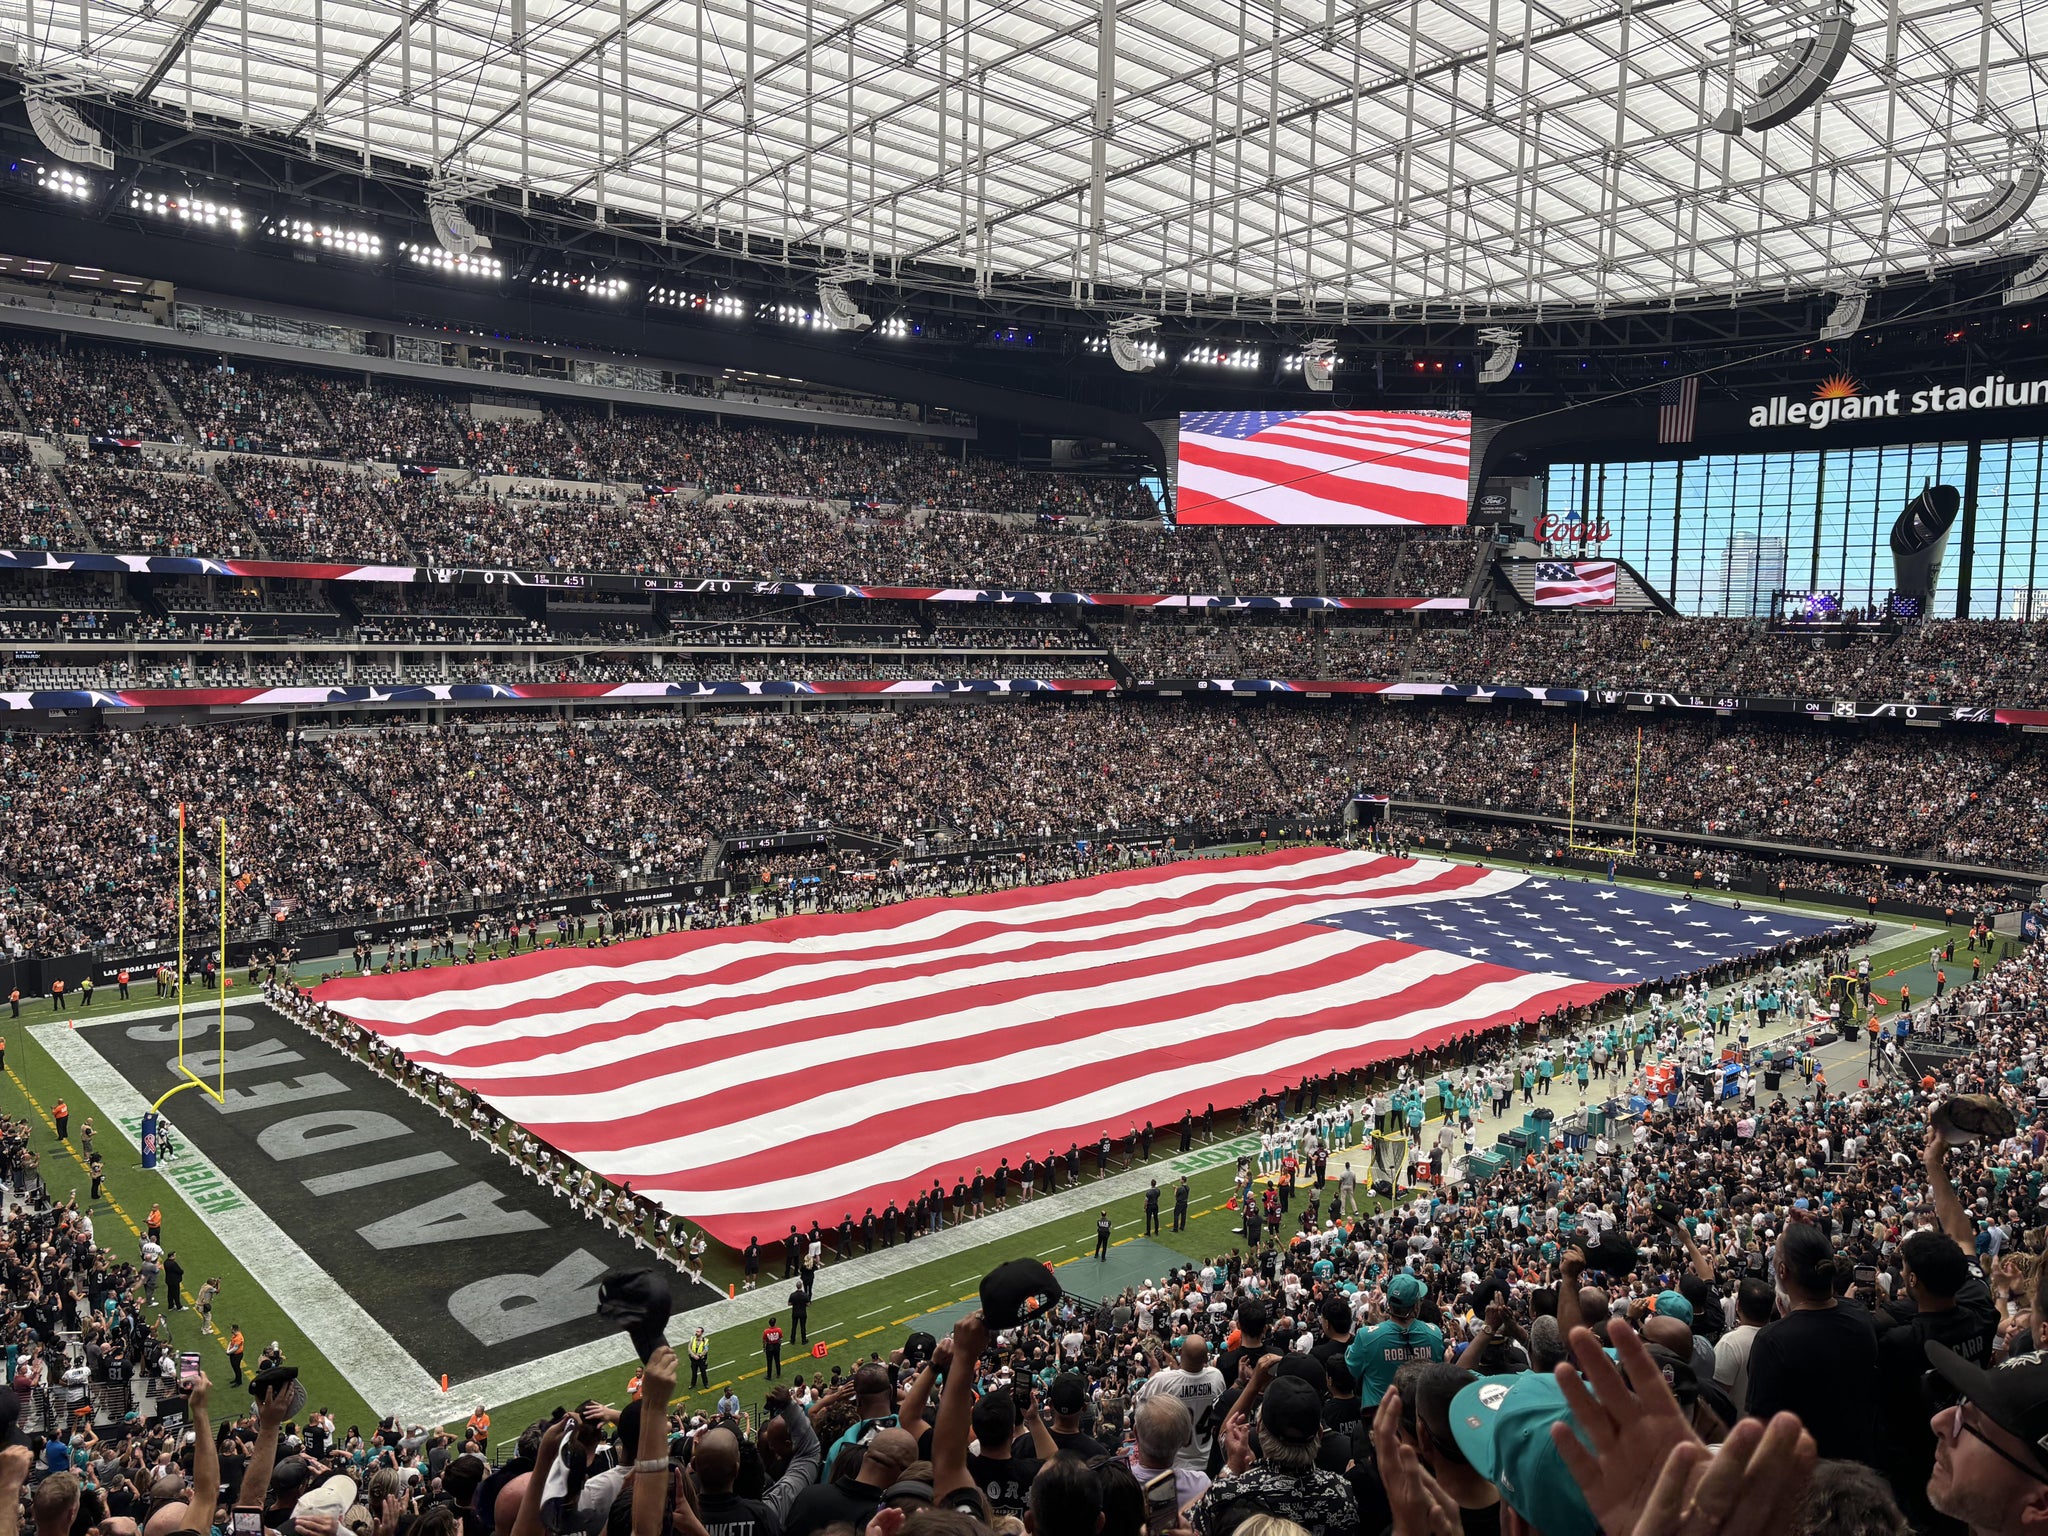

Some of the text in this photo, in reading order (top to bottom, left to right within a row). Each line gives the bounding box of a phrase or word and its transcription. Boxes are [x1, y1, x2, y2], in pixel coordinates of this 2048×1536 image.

[1750, 376, 2048, 430] allegiant stadiu
[1533, 513, 1613, 542] Coors
[1541, 543, 1602, 559] LIGHT
[484, 572, 494, 584] 0
[563, 576, 585, 586] 4:51
[645, 580, 657, 588] ON
[673, 581, 684, 589] 25
[722, 582, 731, 593] 0
[1644, 694, 1653, 705] 0
[1718, 698, 1739, 708] 4:51
[1805, 703, 1820, 711] ON
[1836, 703, 1853, 716] 25
[1906, 706, 1917, 719] 0
[759, 839, 774, 847] 4:51
[103, 969, 118, 978] LAS
[1663, 1084, 1671, 1093] G
[1170, 1136, 1262, 1175] CKOFF
[1417, 1165, 1426, 1175] G
[126, 1014, 611, 1347] RAIDERS
[169, 1162, 248, 1215] NEVER
[1321, 1269, 1331, 1279] 34
[817, 1344, 826, 1356] G
[109, 1367, 123, 1380] 81
[1180, 1382, 1212, 1398] JACKSON
[706, 1520, 755, 1536] NKETT
